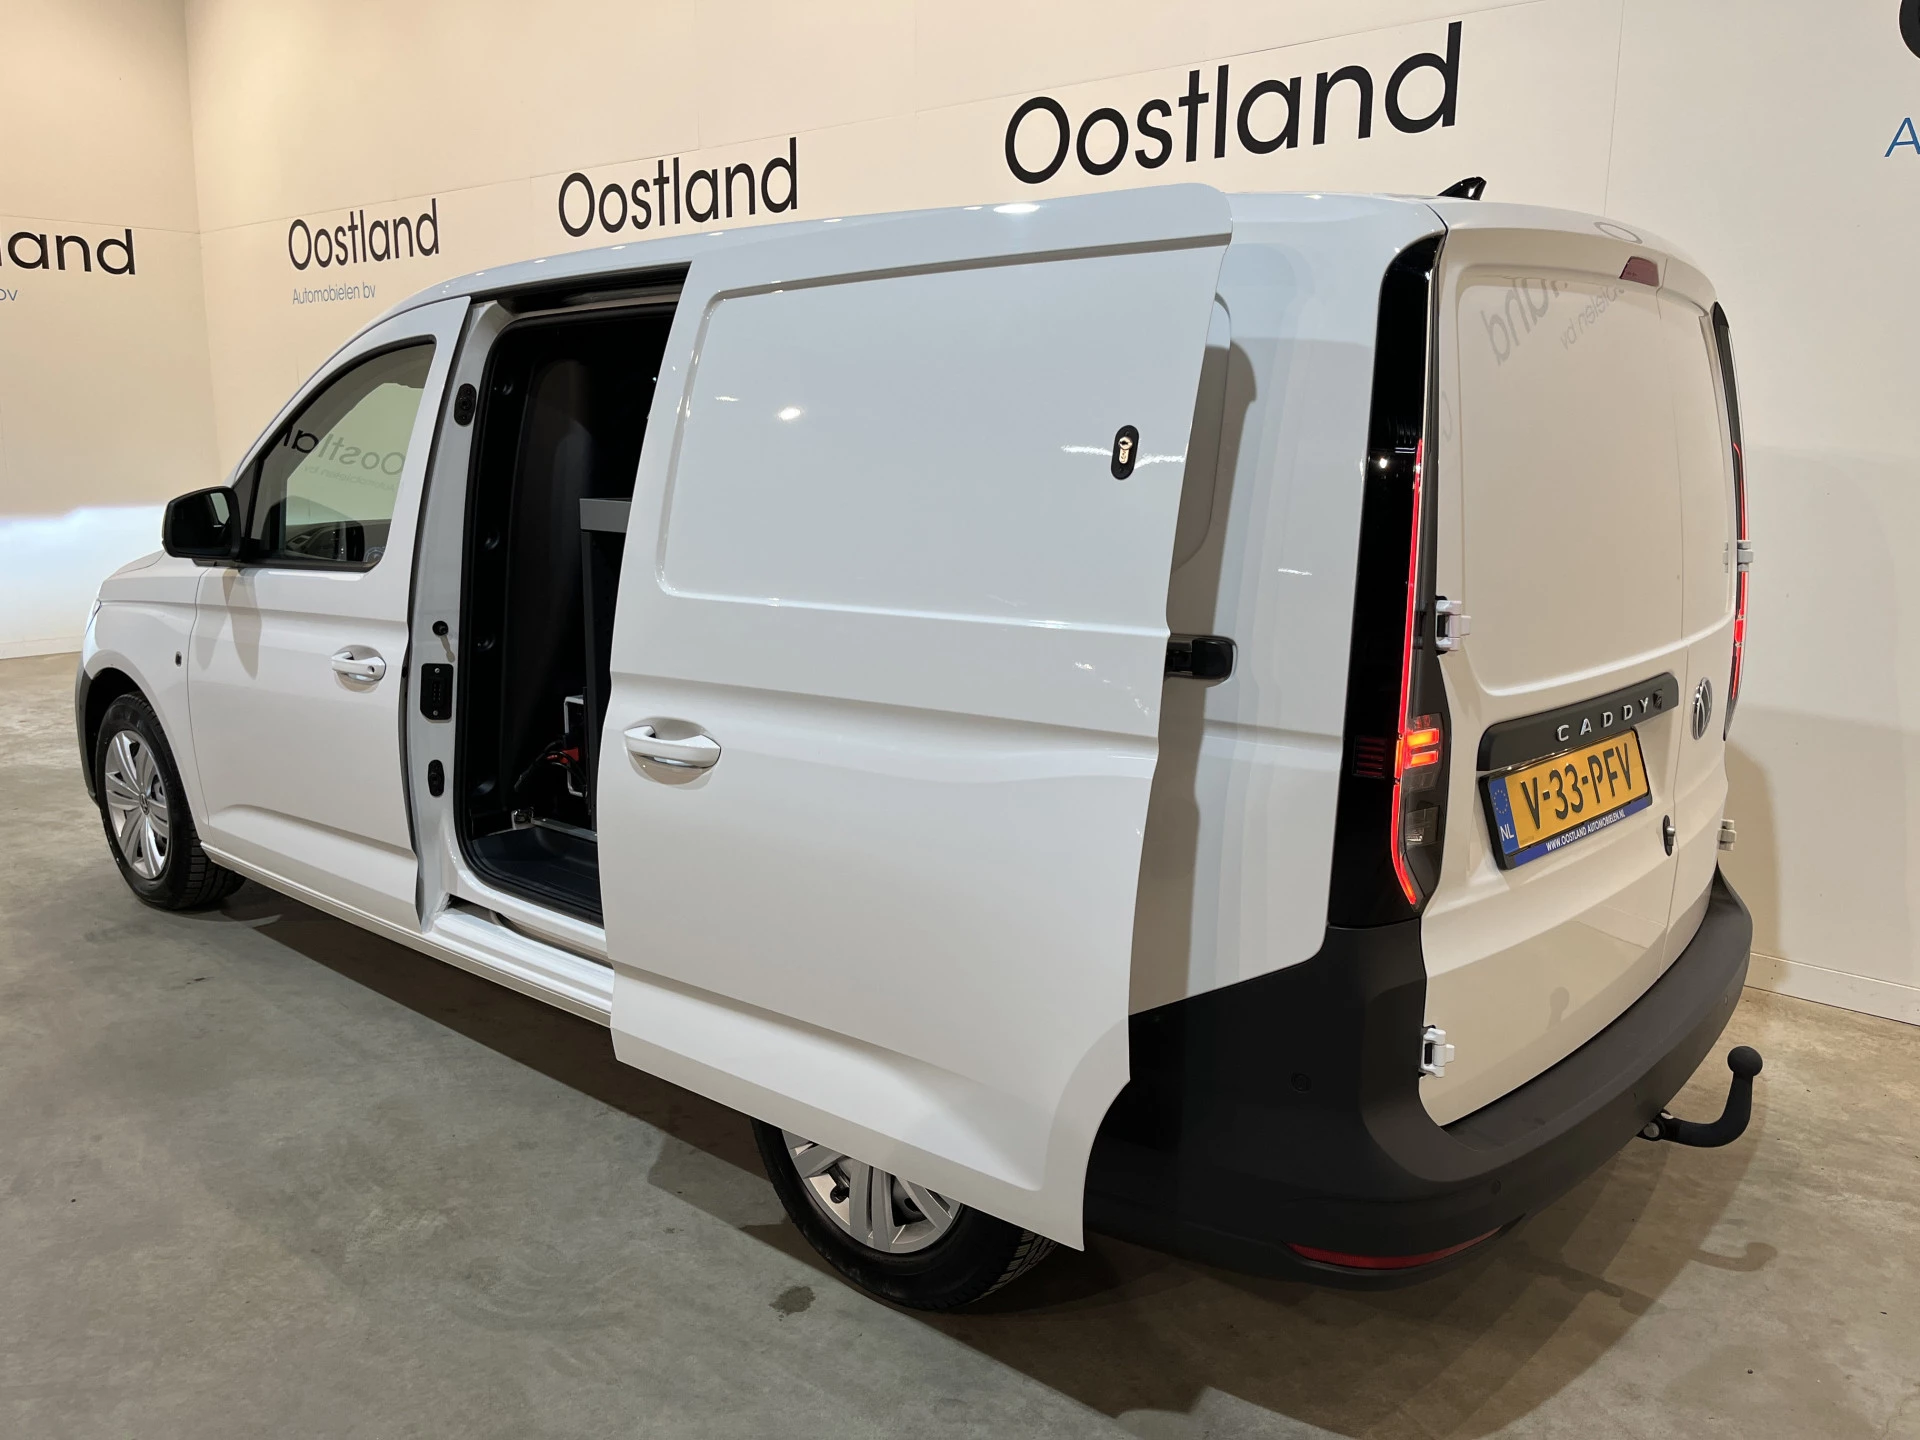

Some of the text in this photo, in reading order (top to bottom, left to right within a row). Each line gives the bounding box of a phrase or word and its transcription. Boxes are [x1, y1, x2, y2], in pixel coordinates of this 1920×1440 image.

[1005, 21, 1463, 184] Oostland
[558, 136, 798, 238] Oostland
[0, 228, 136, 275] and
[288, 198, 440, 271] Oostland
[292, 282, 376, 305] Automobielen bv
[1556, 697, 1649, 742] CADDY
[1520, 743, 1632, 830] V-33-PFV
[1500, 823, 1515, 842] NL
